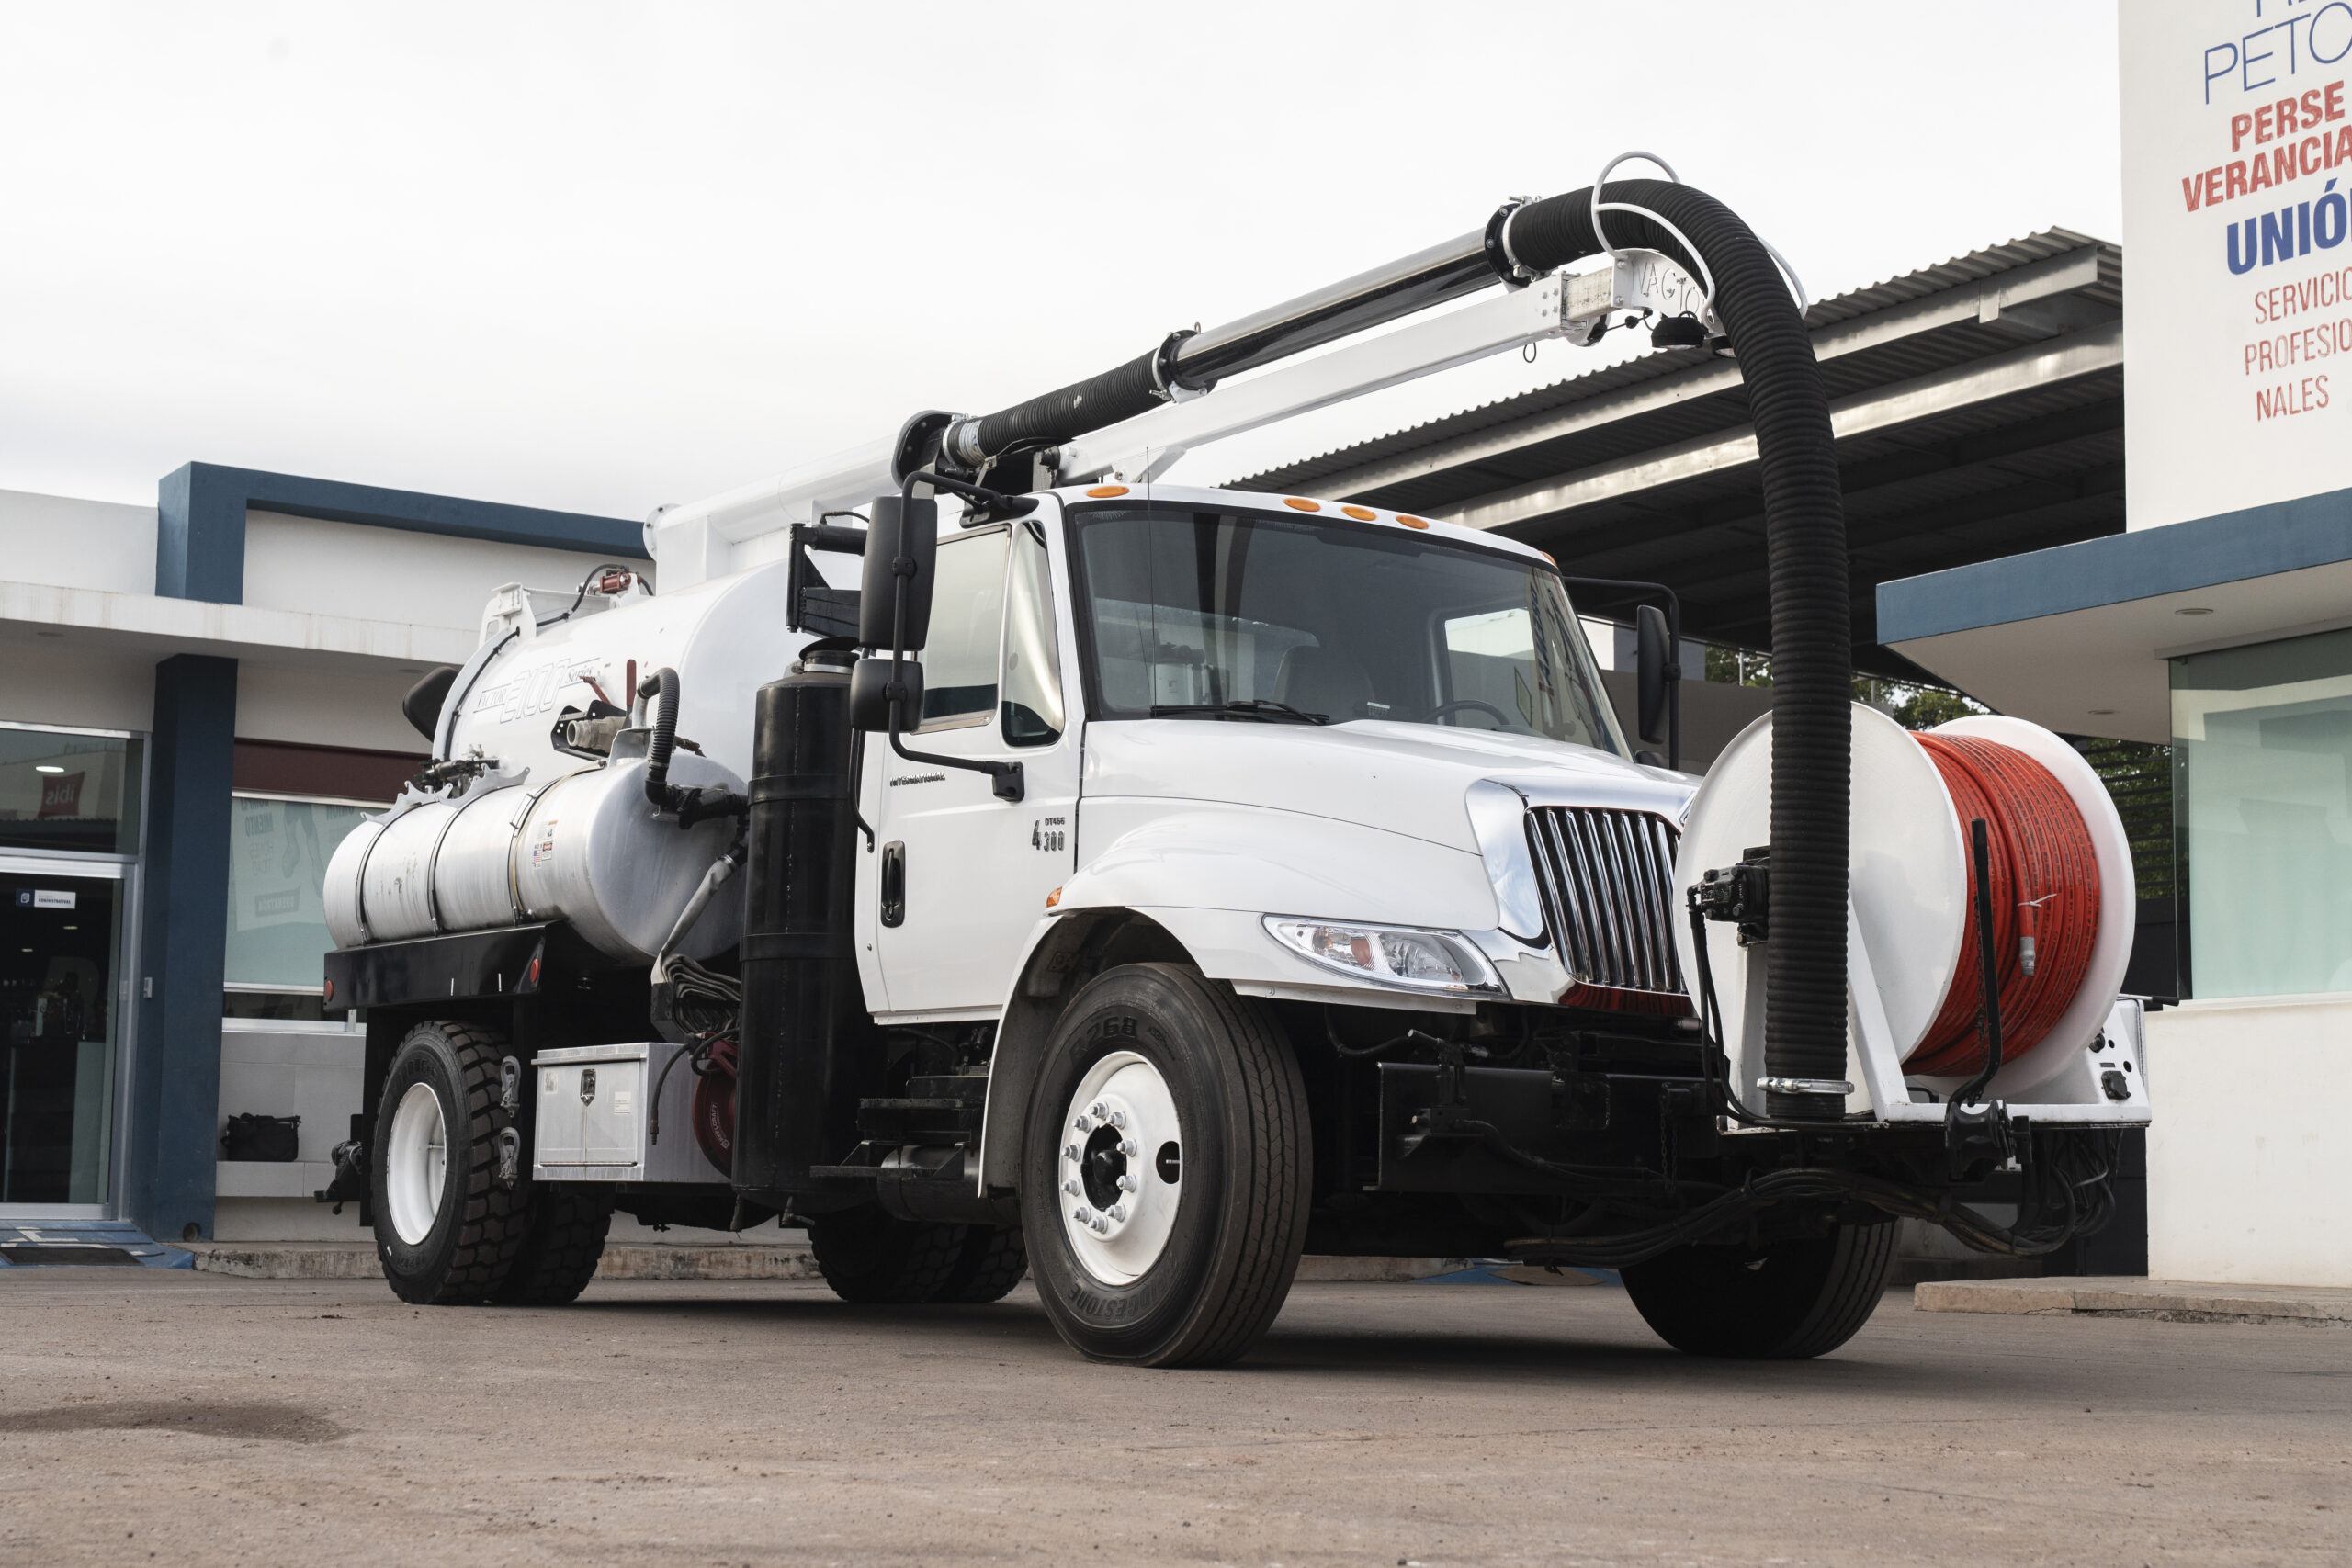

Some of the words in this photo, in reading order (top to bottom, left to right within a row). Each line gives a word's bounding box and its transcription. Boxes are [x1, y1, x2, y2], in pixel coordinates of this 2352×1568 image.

[2205, 2, 2352, 105] PETO
[2232, 80, 2345, 152] PERSE
[2182, 125, 2352, 212] VERANCIA
[2227, 177, 2352, 275] UNIÓ
[2245, 318, 2352, 376] PROFESIO
[2256, 375, 2329, 422] NALES
[500, 658, 571, 724] 2100
[889, 771, 946, 787] INTERNATIONAL
[1045, 817, 1065, 827] DT466
